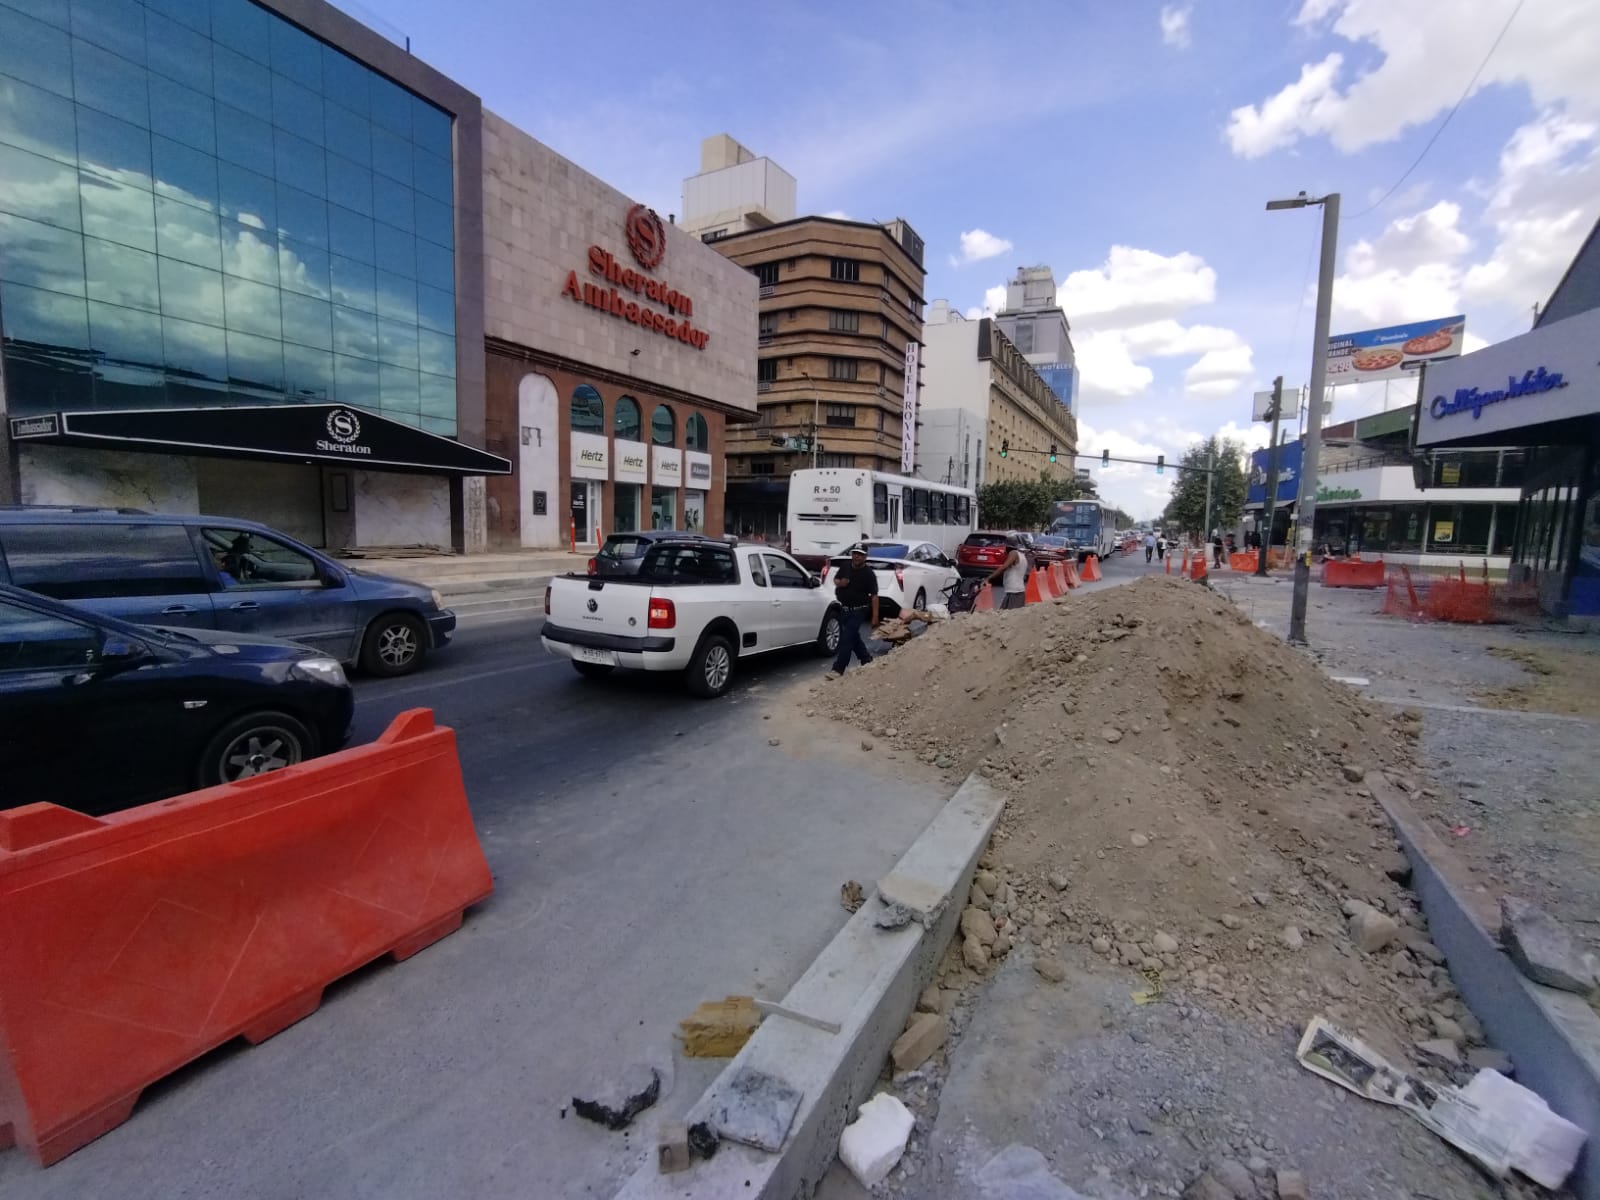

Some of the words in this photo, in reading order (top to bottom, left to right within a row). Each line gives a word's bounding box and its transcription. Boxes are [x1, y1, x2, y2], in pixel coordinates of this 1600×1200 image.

[636, 215, 656, 252] S
[588, 245, 693, 316] Sheraton
[561, 269, 710, 350] Ambassador
[1327, 339, 1353, 351] RIGINAL
[1327, 348, 1349, 357] RANDE
[906, 343, 916, 395] HOTEL
[1430, 386, 1504, 420] Culligan
[1508, 366, 1569, 399] Water
[334, 415, 353, 435] S
[903, 401, 913, 472] ROYALTY
[316, 439, 372, 454] Sheraton
[581, 450, 603, 462] Hertz
[624, 456, 643, 467] Hertz
[661, 462, 678, 472] Hertz
[814, 485, 820, 494] R
[829, 485, 841, 494] 50
